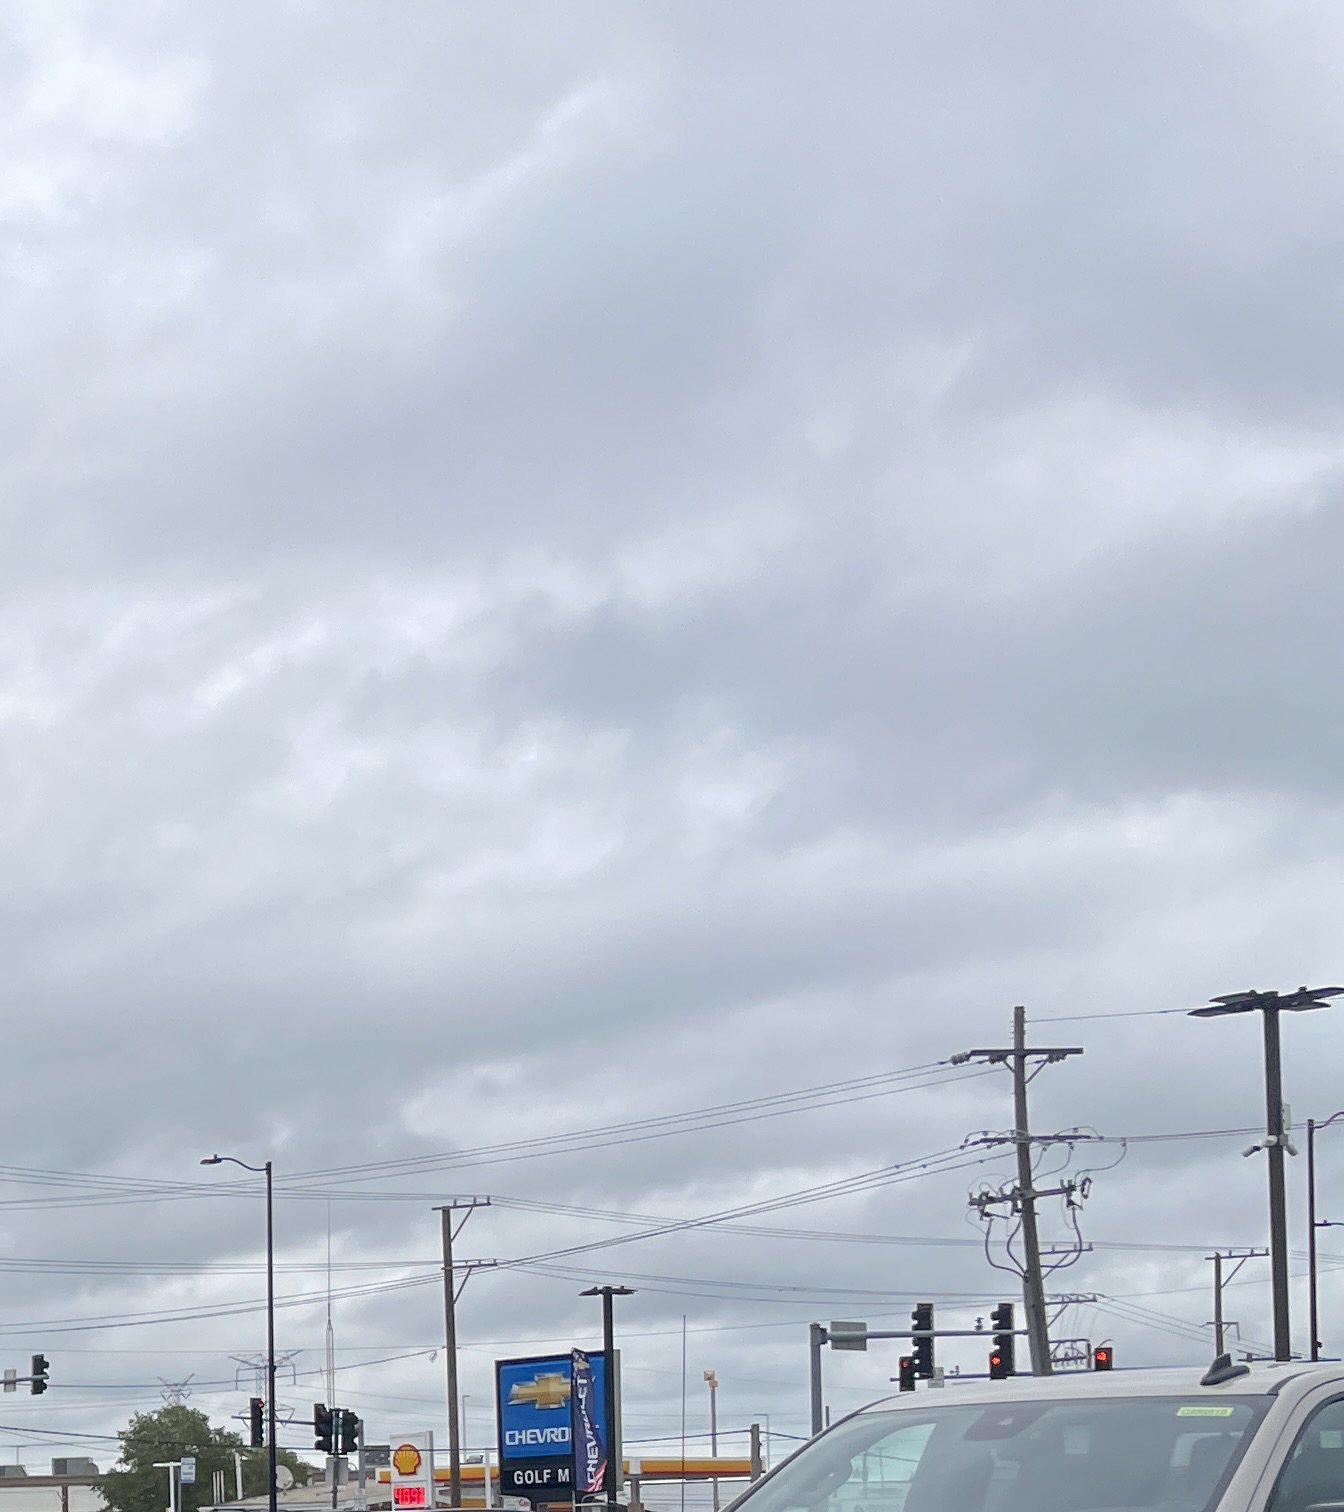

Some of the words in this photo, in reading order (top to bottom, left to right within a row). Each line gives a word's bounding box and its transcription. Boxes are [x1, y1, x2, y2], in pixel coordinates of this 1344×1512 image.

[505, 1426, 572, 1446] CHEVRO
[578, 1376, 599, 1483] CHEVET
[514, 1469, 551, 1485] GOLF
